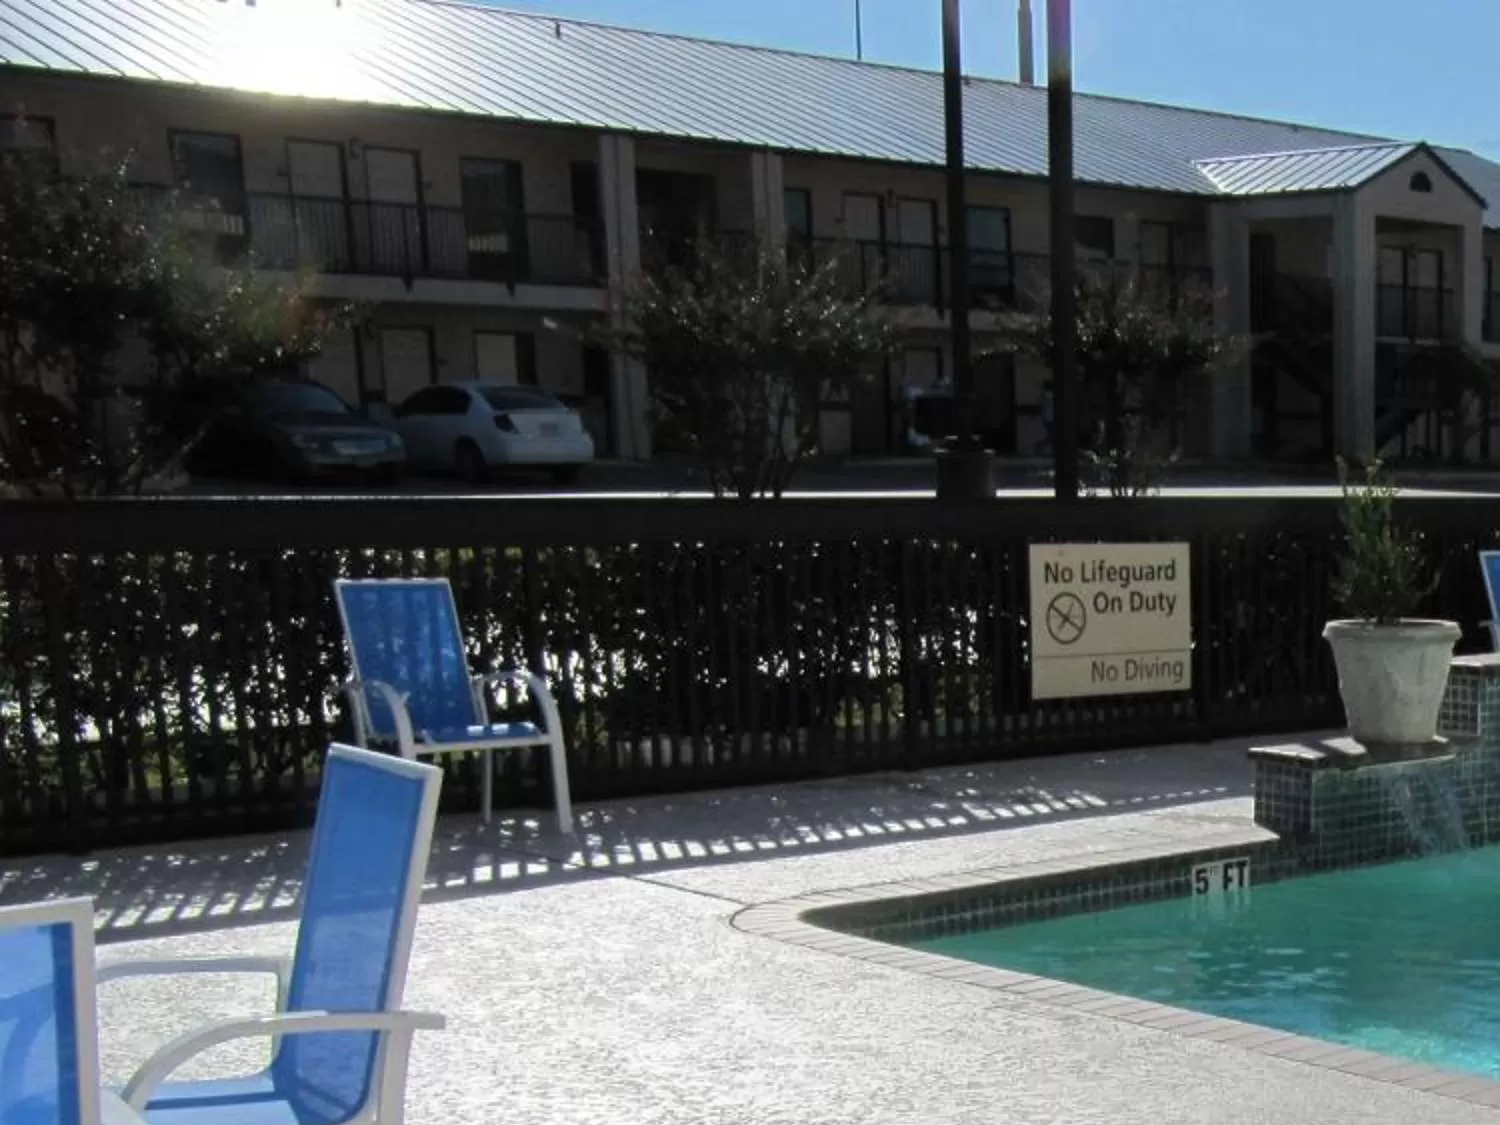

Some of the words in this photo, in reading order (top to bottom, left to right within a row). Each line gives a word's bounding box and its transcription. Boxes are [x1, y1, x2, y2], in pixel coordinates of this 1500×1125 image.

[1044, 560, 1074, 584] No
[1081, 557, 1177, 588] Lifeguard
[1092, 591, 1123, 615] On
[1129, 590, 1177, 617] Duty
[1091, 659, 1119, 683] No
[1124, 656, 1185, 684] Diving
[1195, 867, 1209, 895] 5
[1223, 860, 1248, 891] FT
